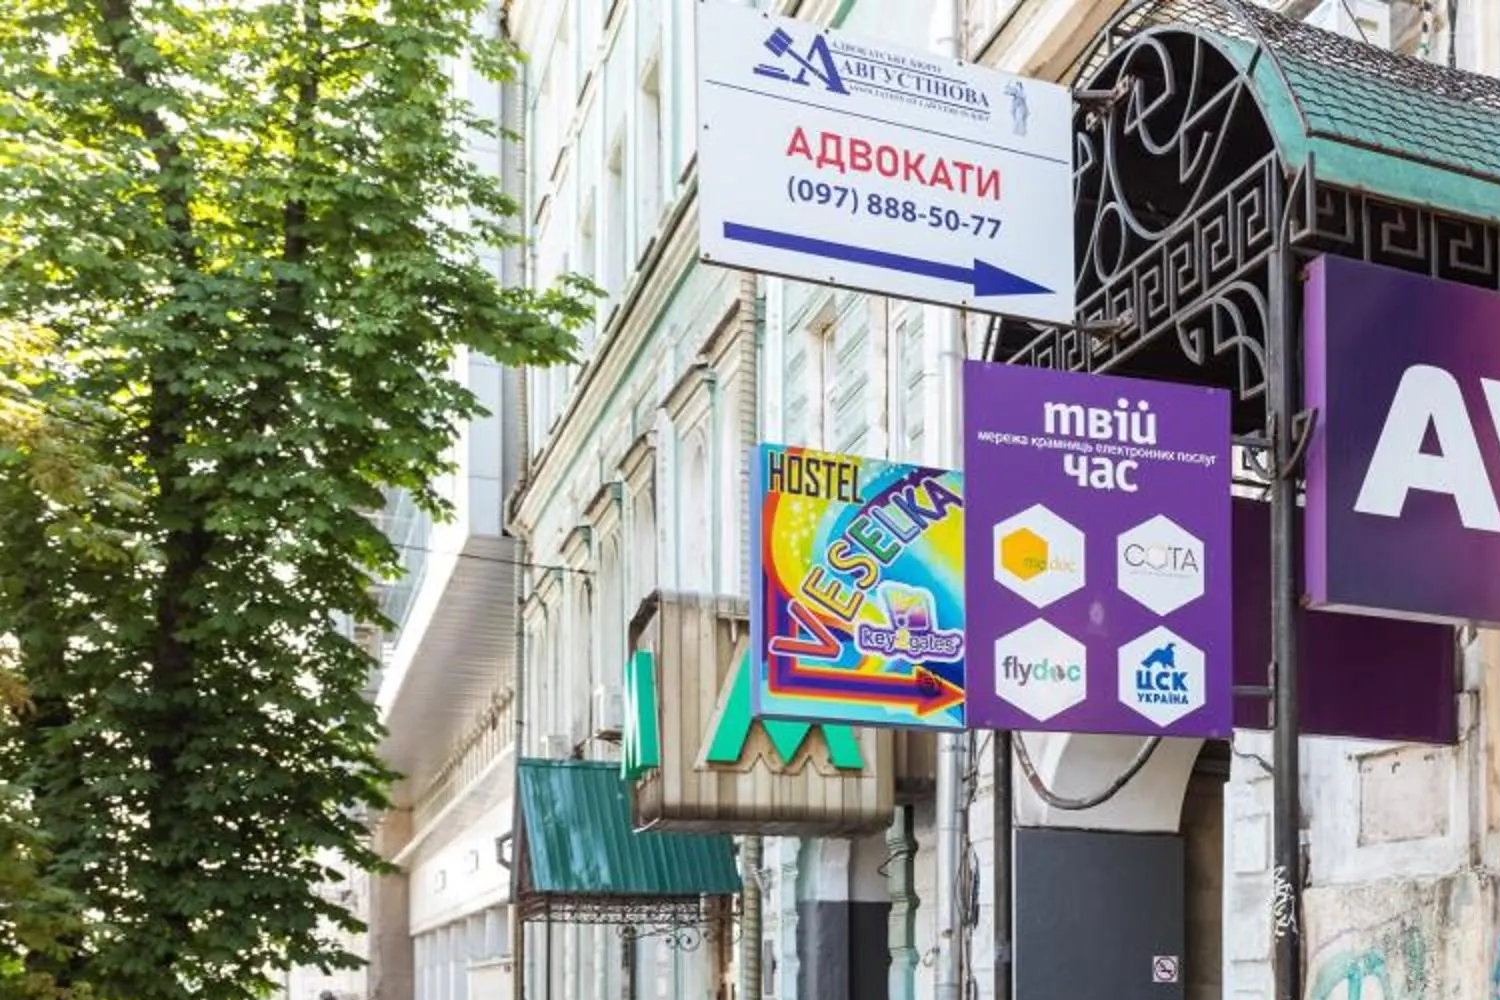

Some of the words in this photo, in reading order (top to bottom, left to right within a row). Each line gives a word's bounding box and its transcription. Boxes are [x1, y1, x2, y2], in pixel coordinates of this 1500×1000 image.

[842, 60, 990, 107] АВГУСТІНОВА
[787, 126, 1001, 201] АДВОКАТИ
[788, 176, 859, 214] (097)
[867, 193, 1002, 239] 888-50-77
[978, 430, 1029, 446] мережа
[1031, 437, 1093, 454] крамниць
[1095, 444, 1175, 462] електронних
[1177, 451, 1216, 468] послуг
[769, 452, 864, 504] HOSTEL
[1063, 454, 1139, 493] час
[770, 478, 965, 657] VESELKA
[1002, 656, 1081, 686] flydoc
[1136, 669, 1188, 691] ЦСК
[1137, 691, 1189, 705] УКРАЇНА
